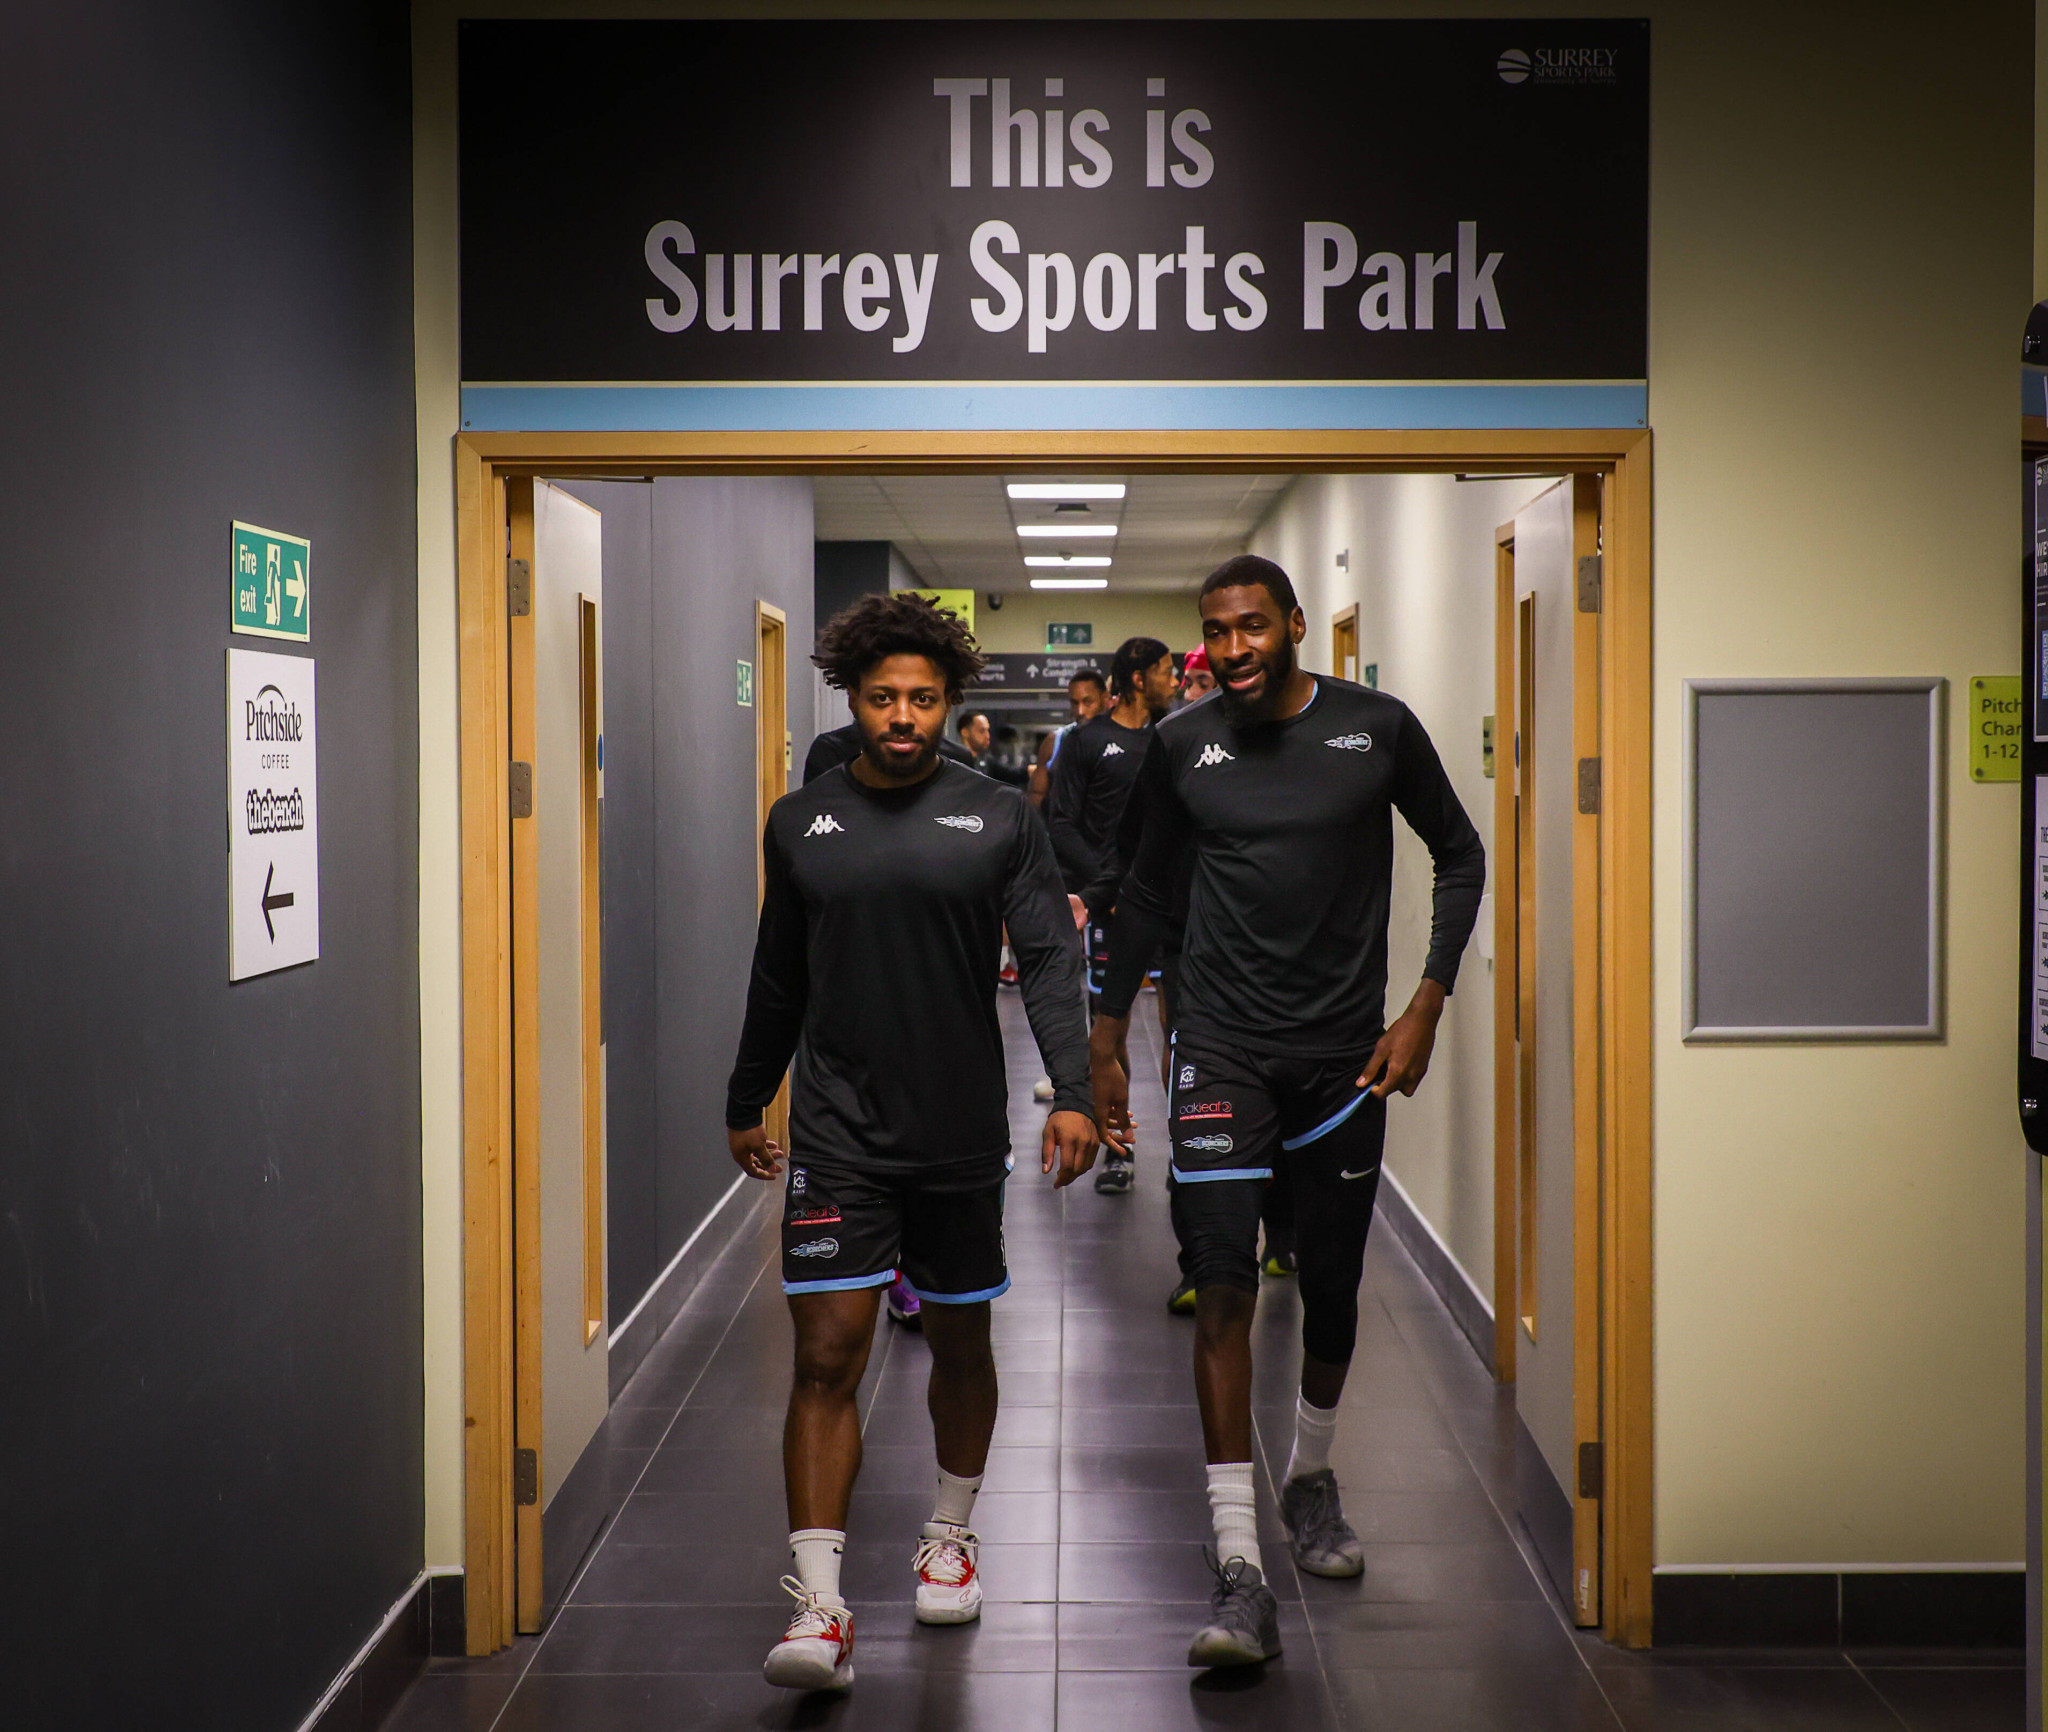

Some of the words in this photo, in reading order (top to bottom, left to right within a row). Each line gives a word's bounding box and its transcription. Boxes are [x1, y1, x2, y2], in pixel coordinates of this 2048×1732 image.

[1533, 66, 1581, 77] SPORTS
[1584, 66, 1616, 77] PARK
[1534, 48, 1618, 66] SURREY
[933, 78, 1113, 188] This
[1146, 78, 1215, 189] is
[645, 220, 939, 354] Surrey
[969, 220, 1268, 354] Sports
[1303, 221, 1506, 331] Park
[239, 543, 257, 576] Fire
[240, 584, 257, 614] exit
[245, 700, 303, 742] Pitchside
[261, 754, 290, 769] COFFEE
[1983, 744, 2019, 759] 1-12
[246, 787, 304, 835] thebench
[1180, 1101, 1222, 1115] oakleaf
